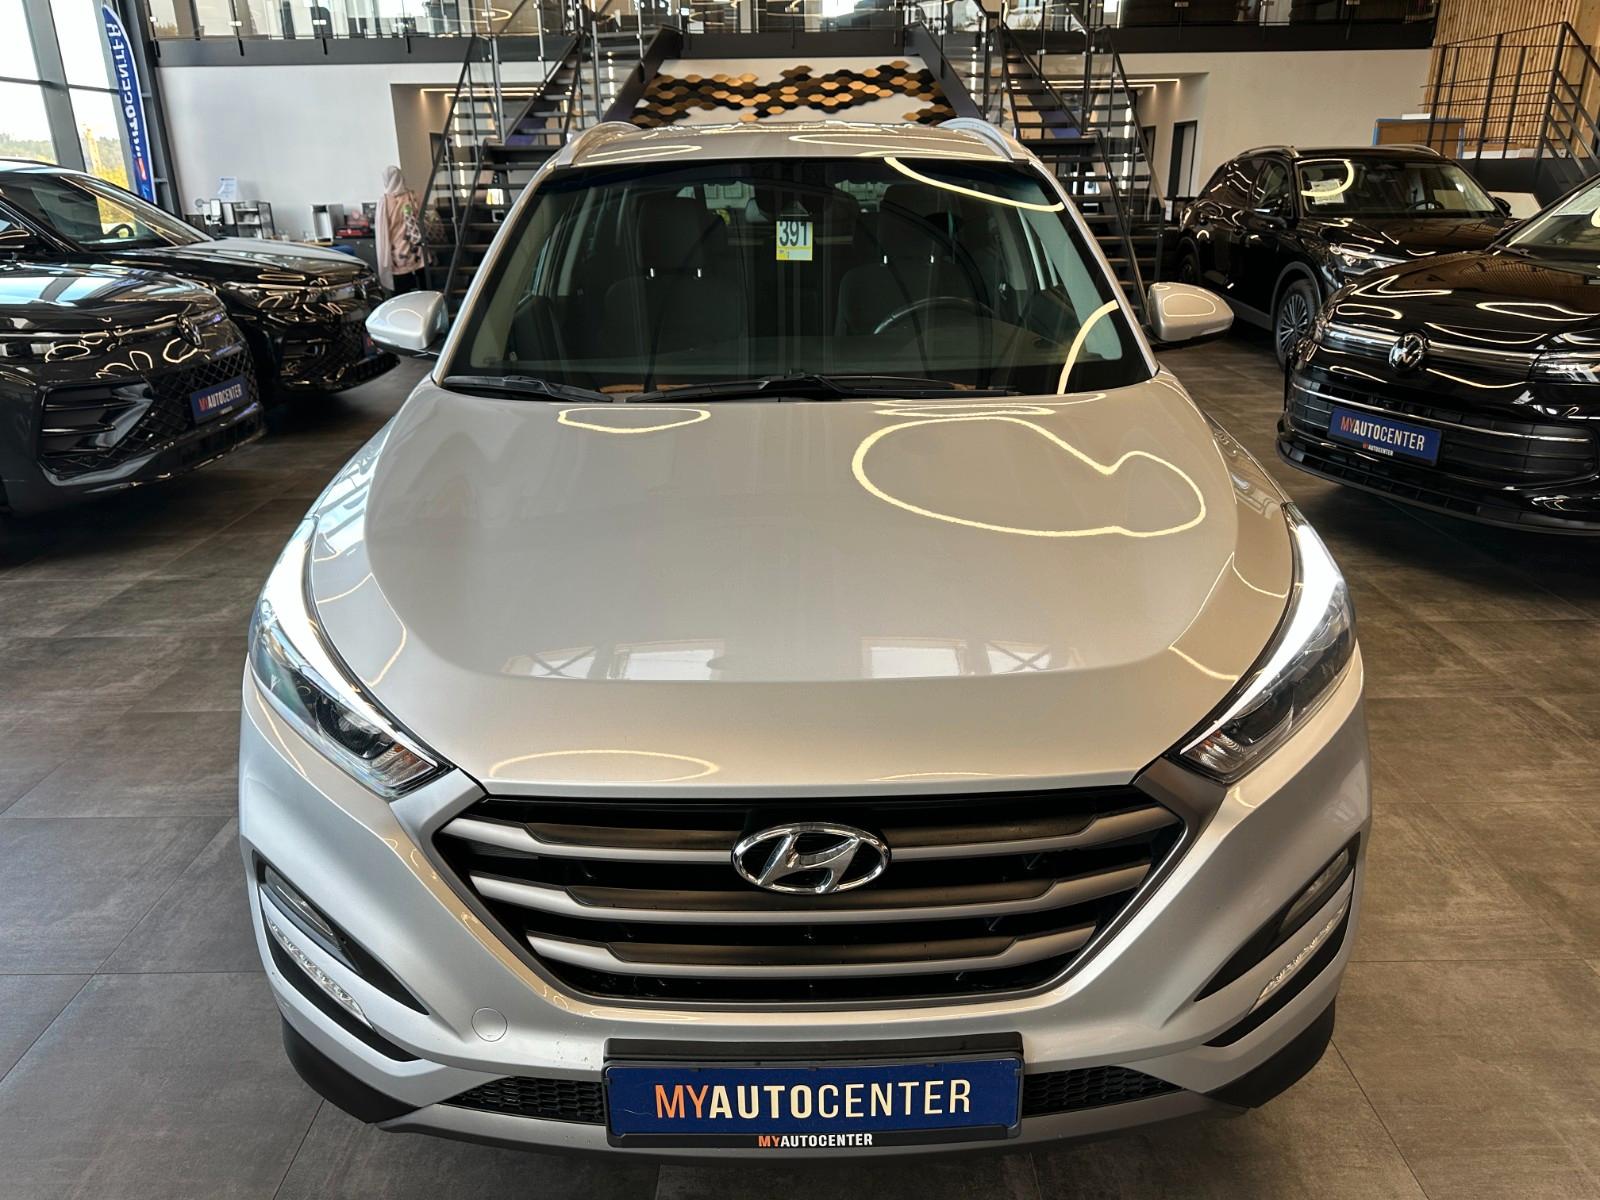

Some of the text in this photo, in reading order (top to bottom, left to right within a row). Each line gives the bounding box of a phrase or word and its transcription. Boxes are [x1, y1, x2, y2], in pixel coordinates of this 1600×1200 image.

[779, 220, 807, 247] 391
[1340, 416, 1425, 451] MYAUTOCENTER
[655, 1079, 971, 1119] MYAUTOCENTER
[758, 1133, 873, 1148] MYAUTOCENTER
